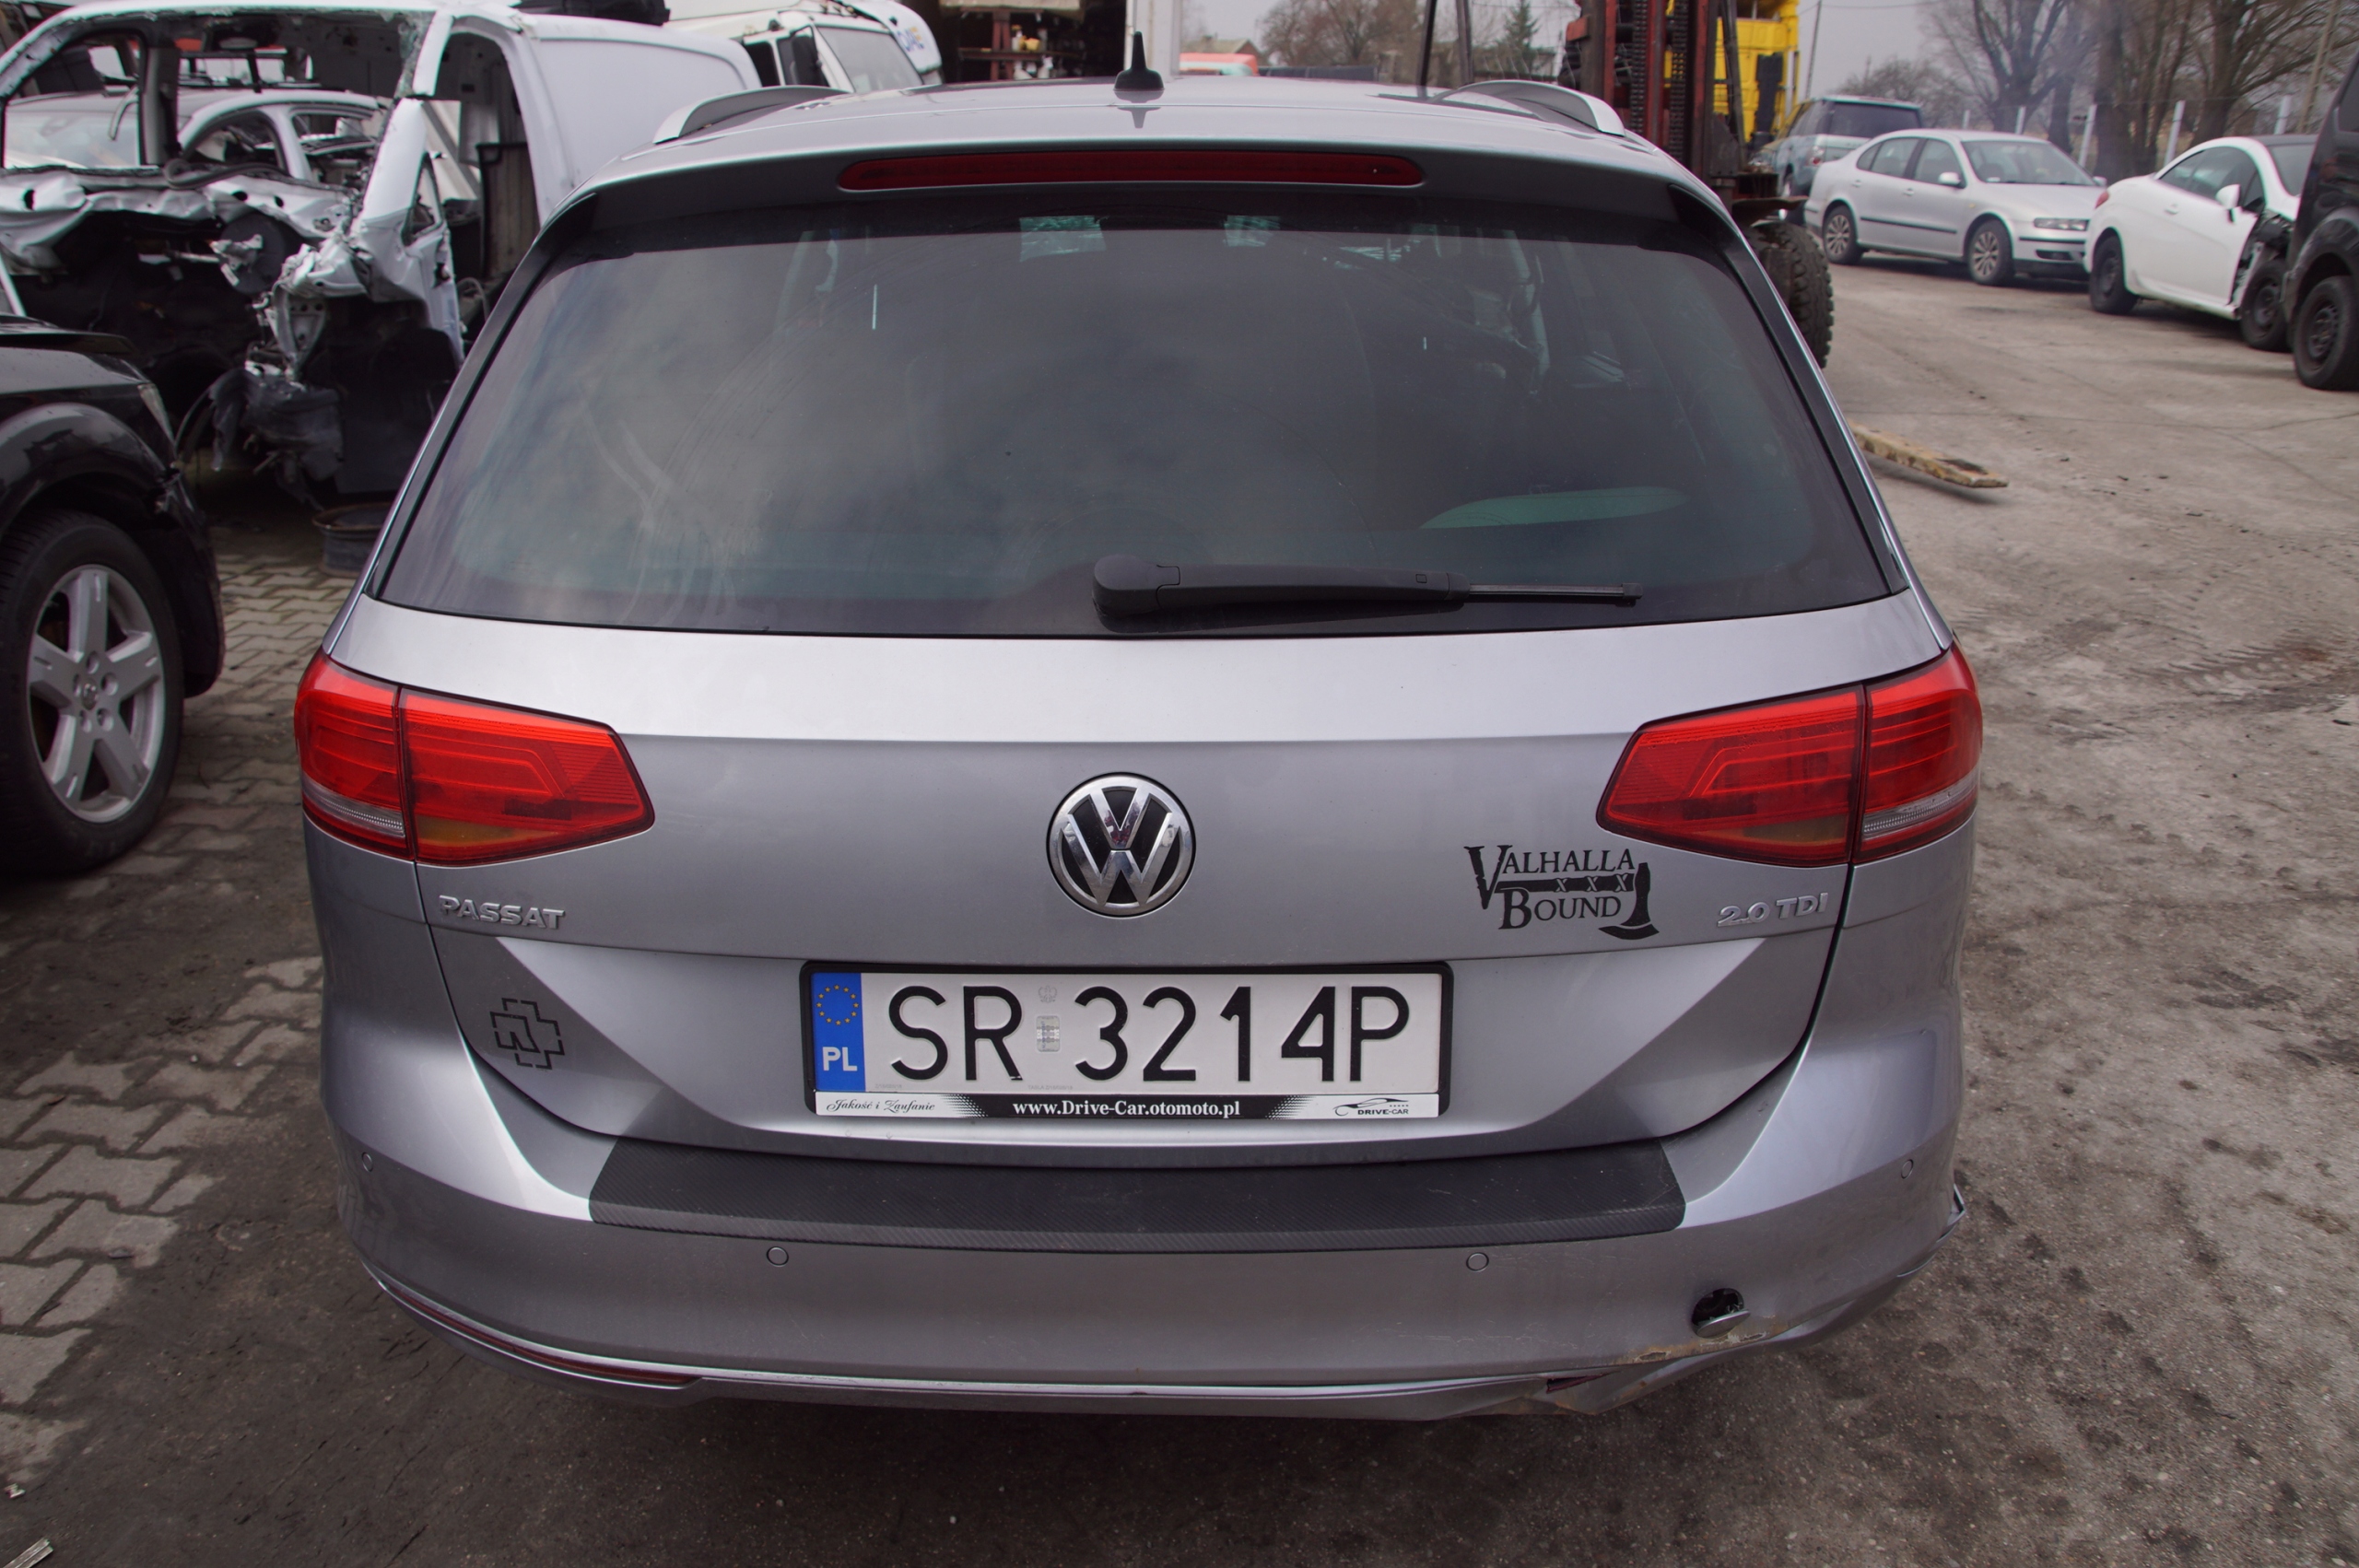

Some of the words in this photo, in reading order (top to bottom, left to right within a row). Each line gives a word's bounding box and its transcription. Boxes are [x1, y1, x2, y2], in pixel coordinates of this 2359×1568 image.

[439, 895, 565, 929] PASSAT
[1717, 902, 1770, 927] 2.0
[1776, 892, 1829, 919] TDI
[888, 986, 1023, 1081] SR
[1074, 986, 1410, 1082] 3214P
[822, 1047, 858, 1071] PL
[827, 1099, 873, 1112] Jakość
[884, 1099, 935, 1113] Zaufanie
[1013, 1100, 1240, 1118] www.Drive-Car.otomoto.pl
